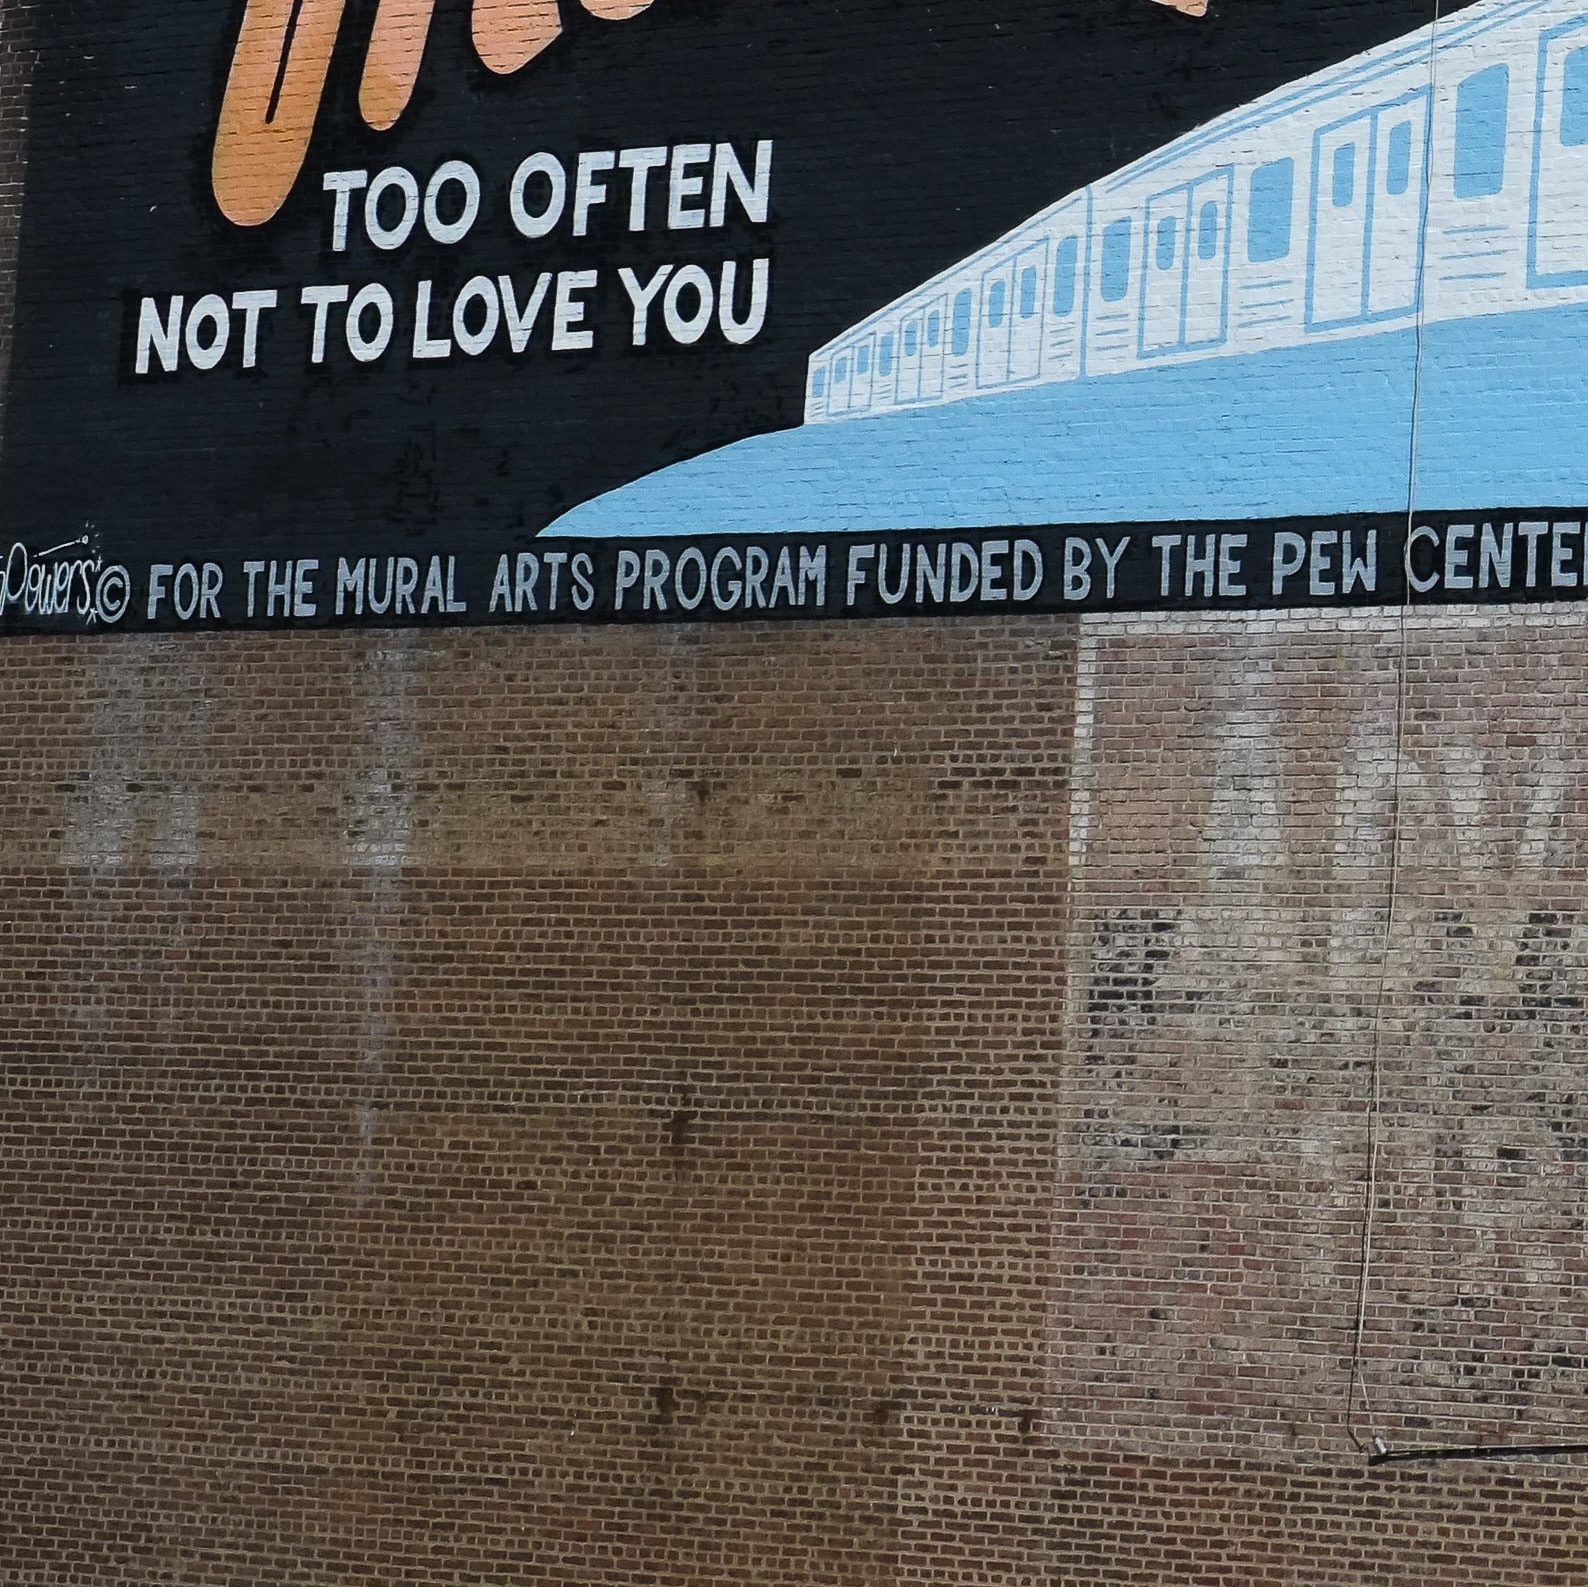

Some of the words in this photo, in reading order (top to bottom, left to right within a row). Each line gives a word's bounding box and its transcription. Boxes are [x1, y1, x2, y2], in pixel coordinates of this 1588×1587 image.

[322, 159, 481, 252] TOO
[509, 139, 774, 239] OFTEN
[135, 289, 278, 374] NOT
[300, 282, 394, 364] TO
[412, 269, 598, 359] LOVE
[617, 257, 770, 346] YOU
[147, 562, 223, 620] FOR
[243, 559, 319, 617] THE
[335, 555, 467, 615] MURAL
[489, 552, 594, 612] ARTS
[614, 544, 826, 611] PROGRAM
[846, 539, 1043, 606] FUNDED
[1063, 536, 1131, 601] BY
[1151, 533, 1248, 597] THE
[1272, 529, 1377, 596] PEW
